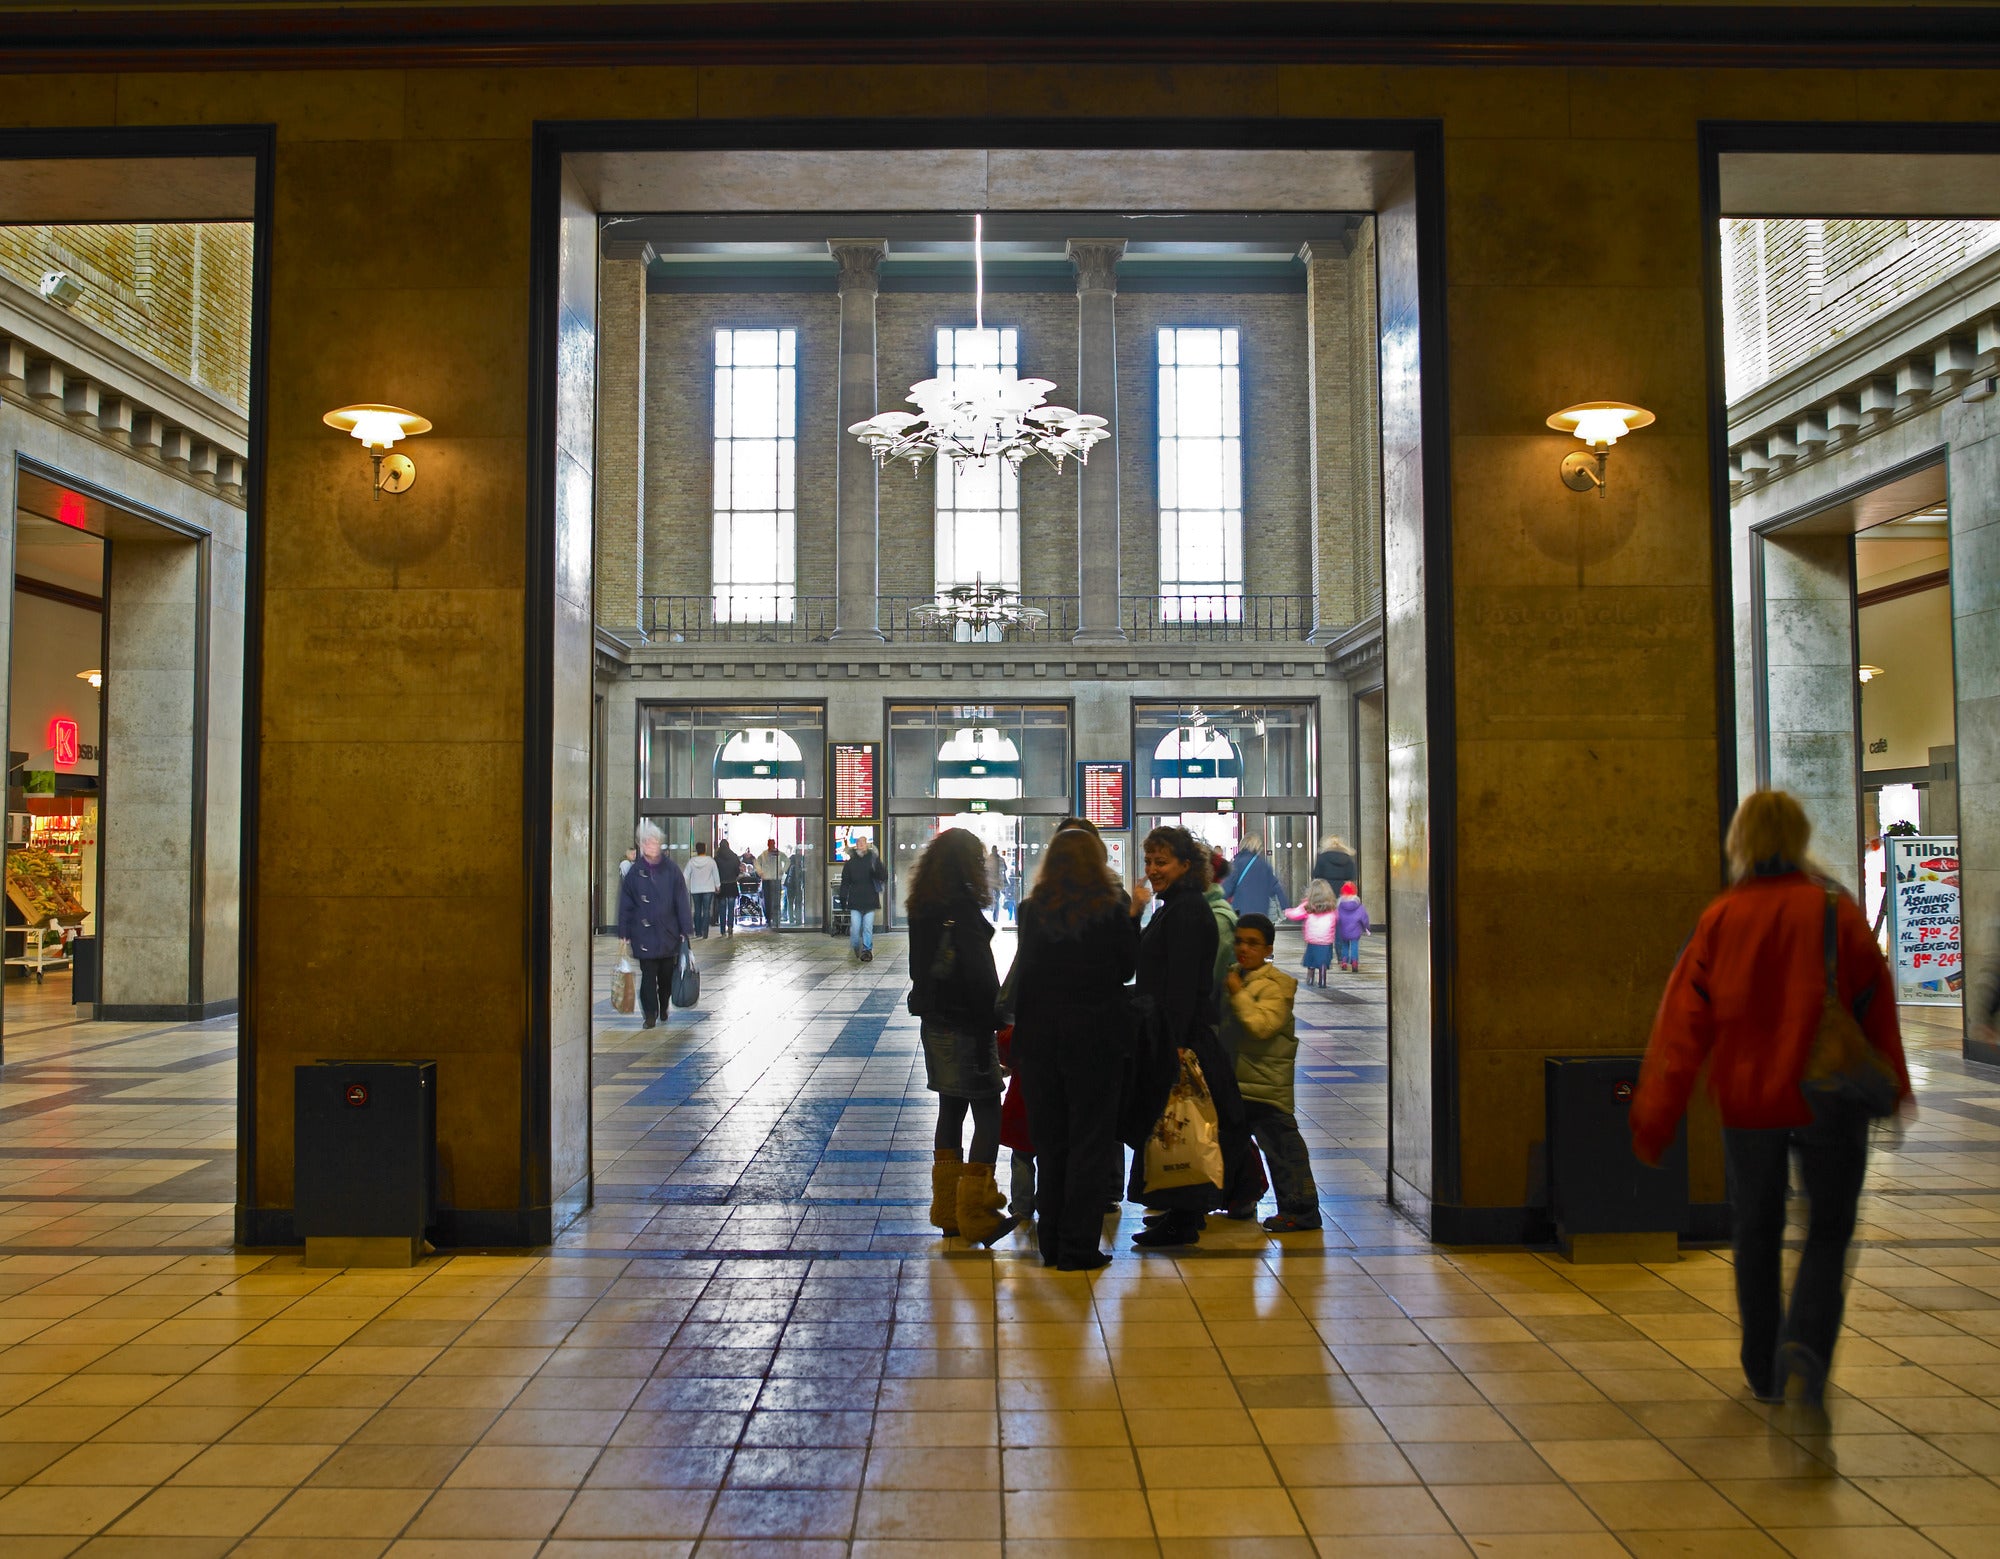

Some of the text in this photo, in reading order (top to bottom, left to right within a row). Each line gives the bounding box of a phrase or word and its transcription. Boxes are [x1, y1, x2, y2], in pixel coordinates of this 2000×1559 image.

[59, 727, 73, 758] K
[1869, 738, 1888, 754] café
[1902, 843, 1959, 857] Tilbu
[1900, 883, 1926, 896] NYE
[1908, 903, 1950, 915] TIDER
